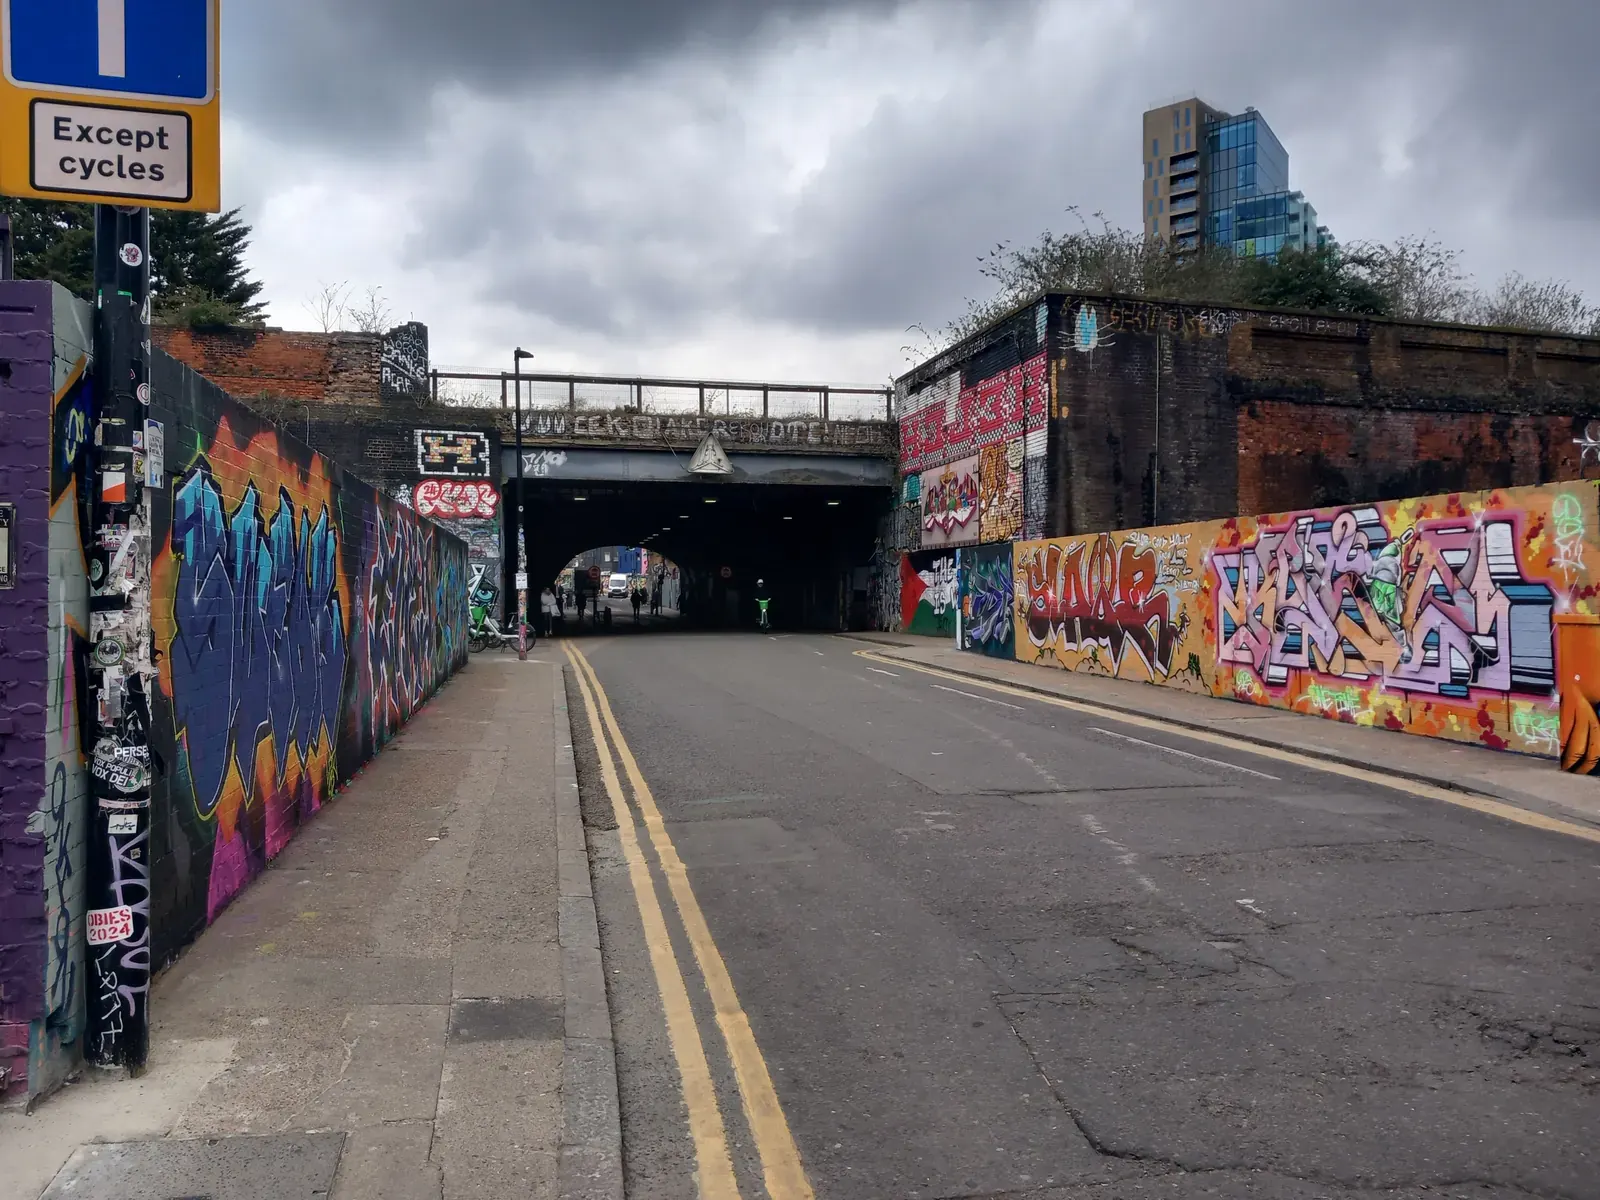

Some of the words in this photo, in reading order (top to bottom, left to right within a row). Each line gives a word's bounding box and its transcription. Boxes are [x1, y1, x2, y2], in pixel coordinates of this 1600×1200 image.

[53, 115, 169, 152] Except
[58, 154, 165, 182] cycles
[92, 763, 109, 780] VOX
[109, 773, 129, 787] DEI
[90, 922, 131, 941] 2024
